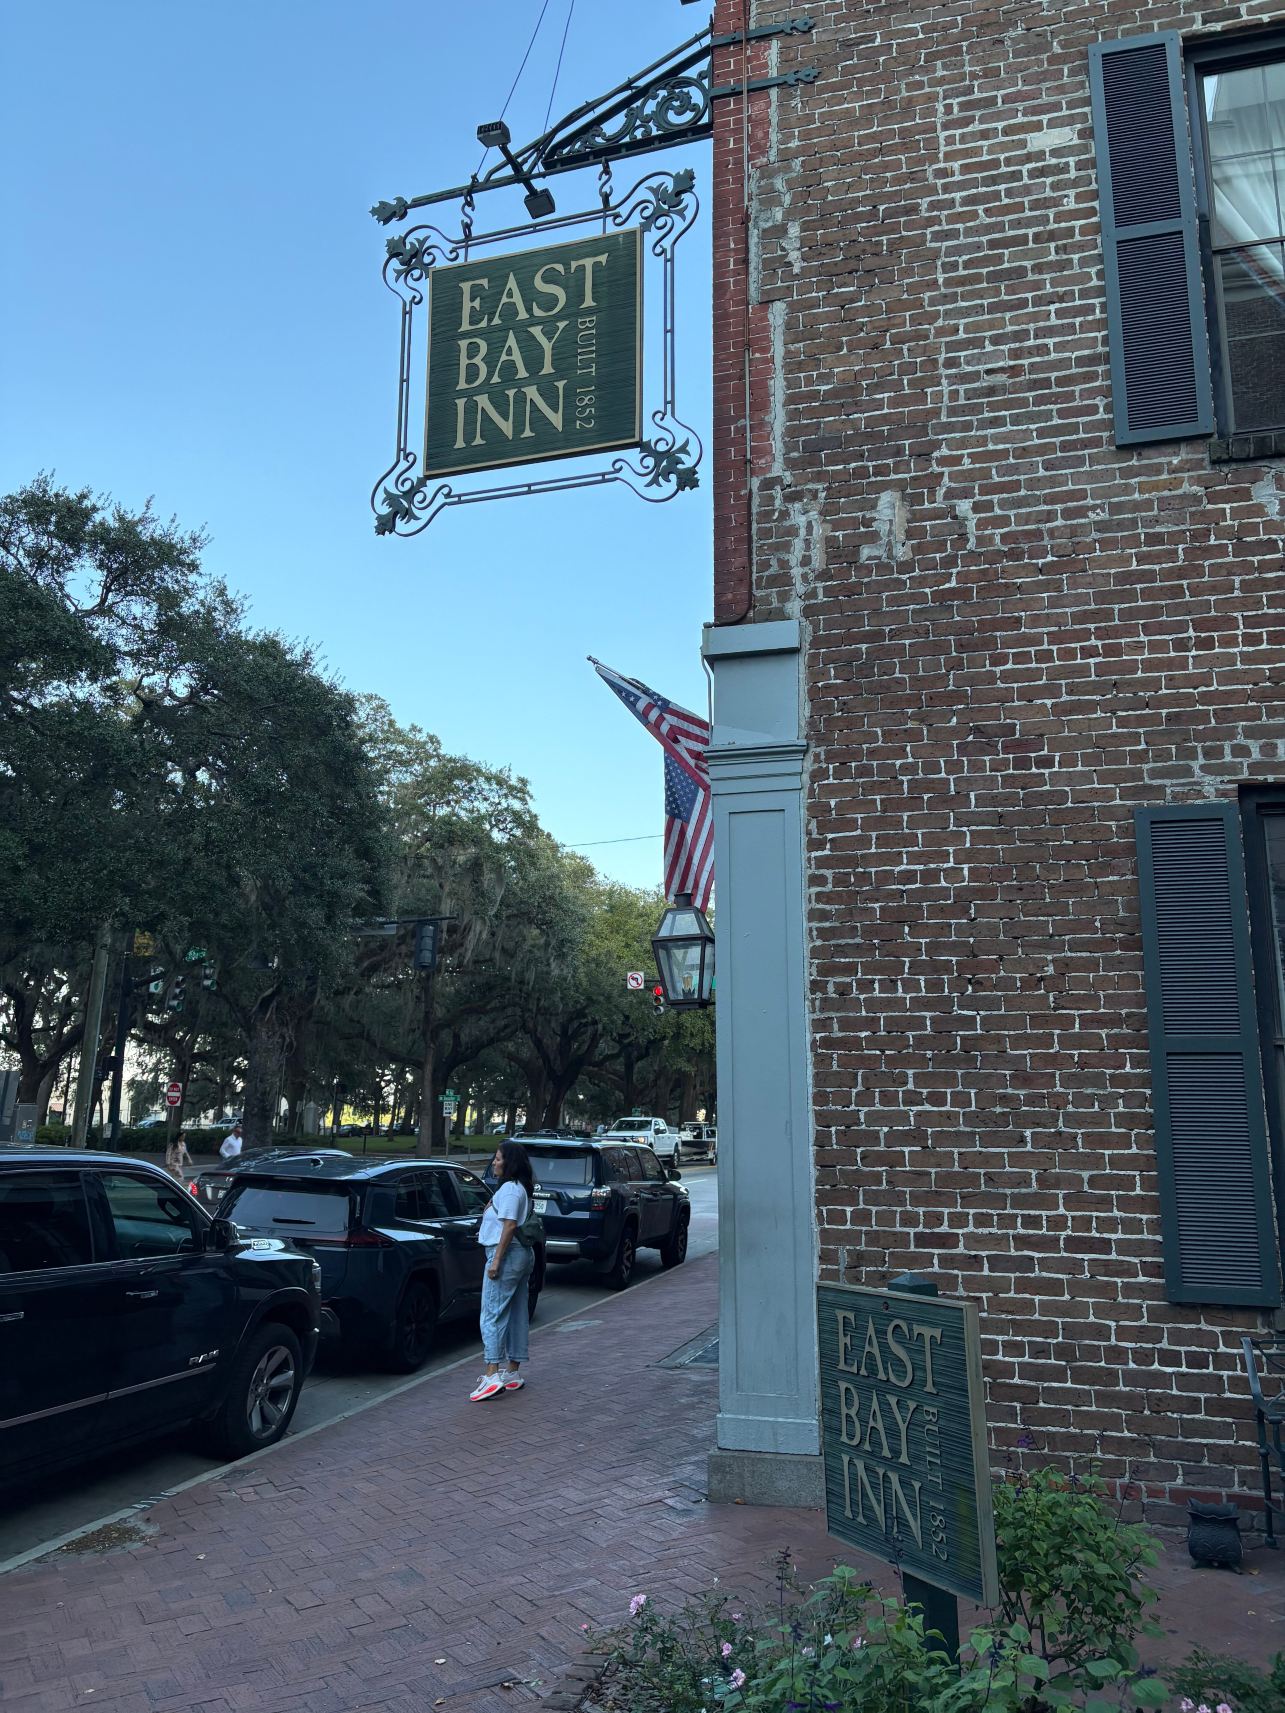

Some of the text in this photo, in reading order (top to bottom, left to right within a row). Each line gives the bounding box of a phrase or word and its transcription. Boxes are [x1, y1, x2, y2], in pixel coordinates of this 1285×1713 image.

[458, 252, 609, 332] EAST
[455, 320, 570, 391] BAY
[575, 315, 597, 430] BUILT 1852
[453, 379, 568, 449] INN
[188, 1349, 220, 1366] RAM
[835, 1309, 942, 1394] EAST
[838, 1381, 918, 1465] BAY
[841, 1453, 923, 1550] INN
[923, 1405, 948, 1561] BUILT 1852
